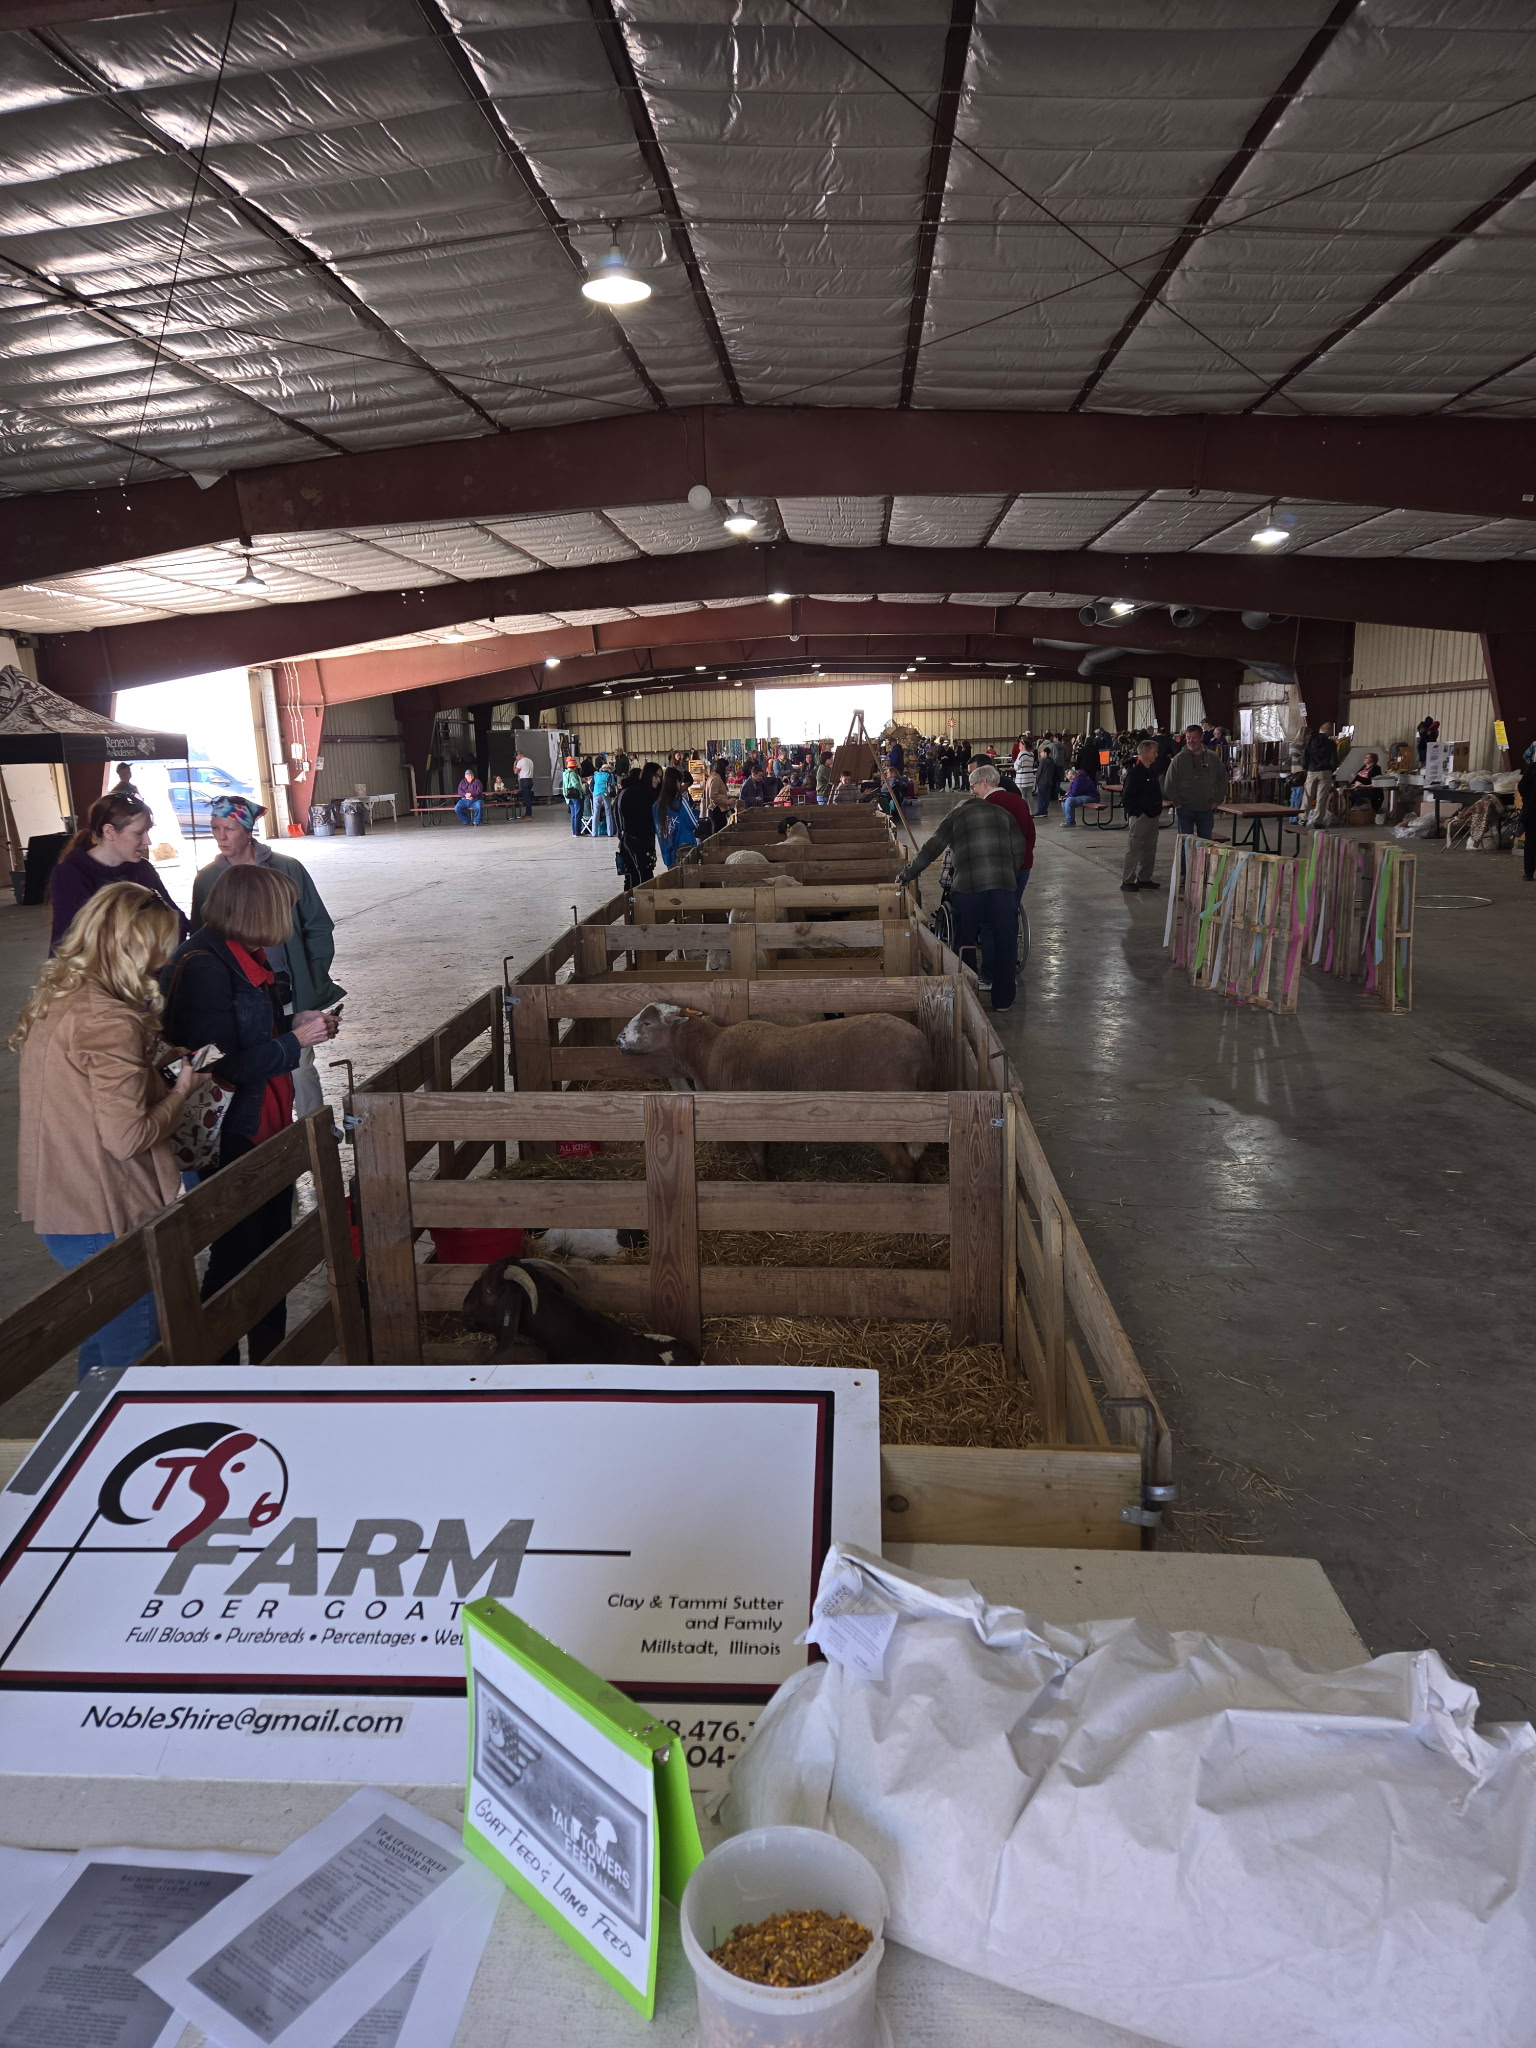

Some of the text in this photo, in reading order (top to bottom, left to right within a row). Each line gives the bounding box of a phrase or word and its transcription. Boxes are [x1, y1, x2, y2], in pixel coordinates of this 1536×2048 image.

[105, 736, 136, 749] Renewal
[111, 748, 136, 757] Andersen
[153, 1517, 535, 1599] FARM
[140, 1599, 466, 1621] BOER GOAT
[607, 1594, 784, 1611] Clay & Tammi Sutter
[685, 1616, 783, 1633] and Family
[125, 1627, 465, 1648] Full Bloods Purebreds Percentages Wet
[641, 1639, 781, 1656] Millstadt, Illinois
[80, 1704, 404, 1735] NobleShire@gmail.com
[378, 1839, 421, 1869] MAINTAINER
[402, 1843, 423, 1859] GOAT
[421, 1856, 448, 1873] CREEP
[563, 1836, 597, 1881] FEED
[580, 1831, 631, 1890] TOWERS
